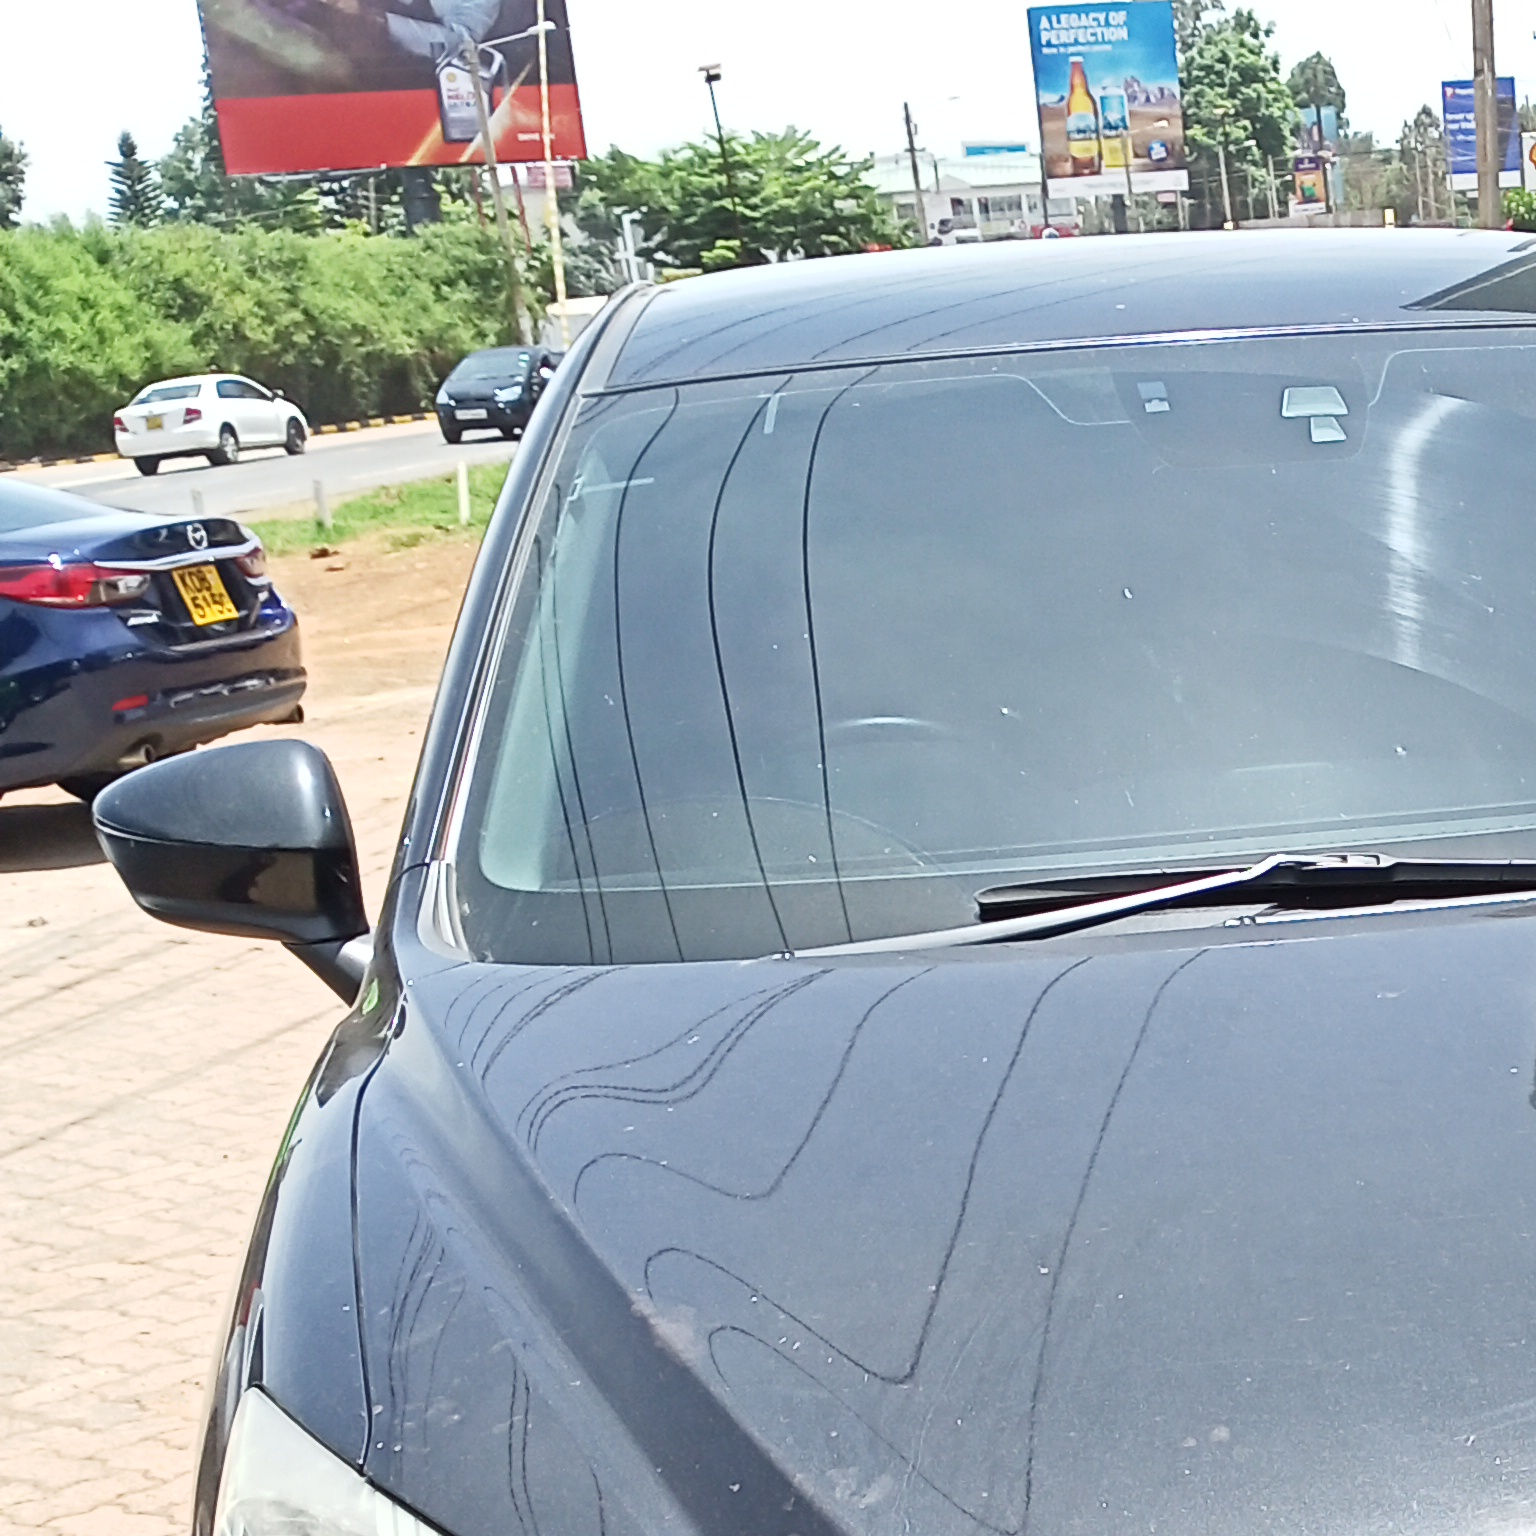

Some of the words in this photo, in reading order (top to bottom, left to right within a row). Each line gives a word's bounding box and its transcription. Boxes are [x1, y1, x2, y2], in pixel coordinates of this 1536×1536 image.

[1040, 15, 1051, 30] A
[1051, 12, 1107, 29] LEGACY
[1108, 10, 1128, 26] OF
[1041, 26, 1128, 45] PERFECTION
